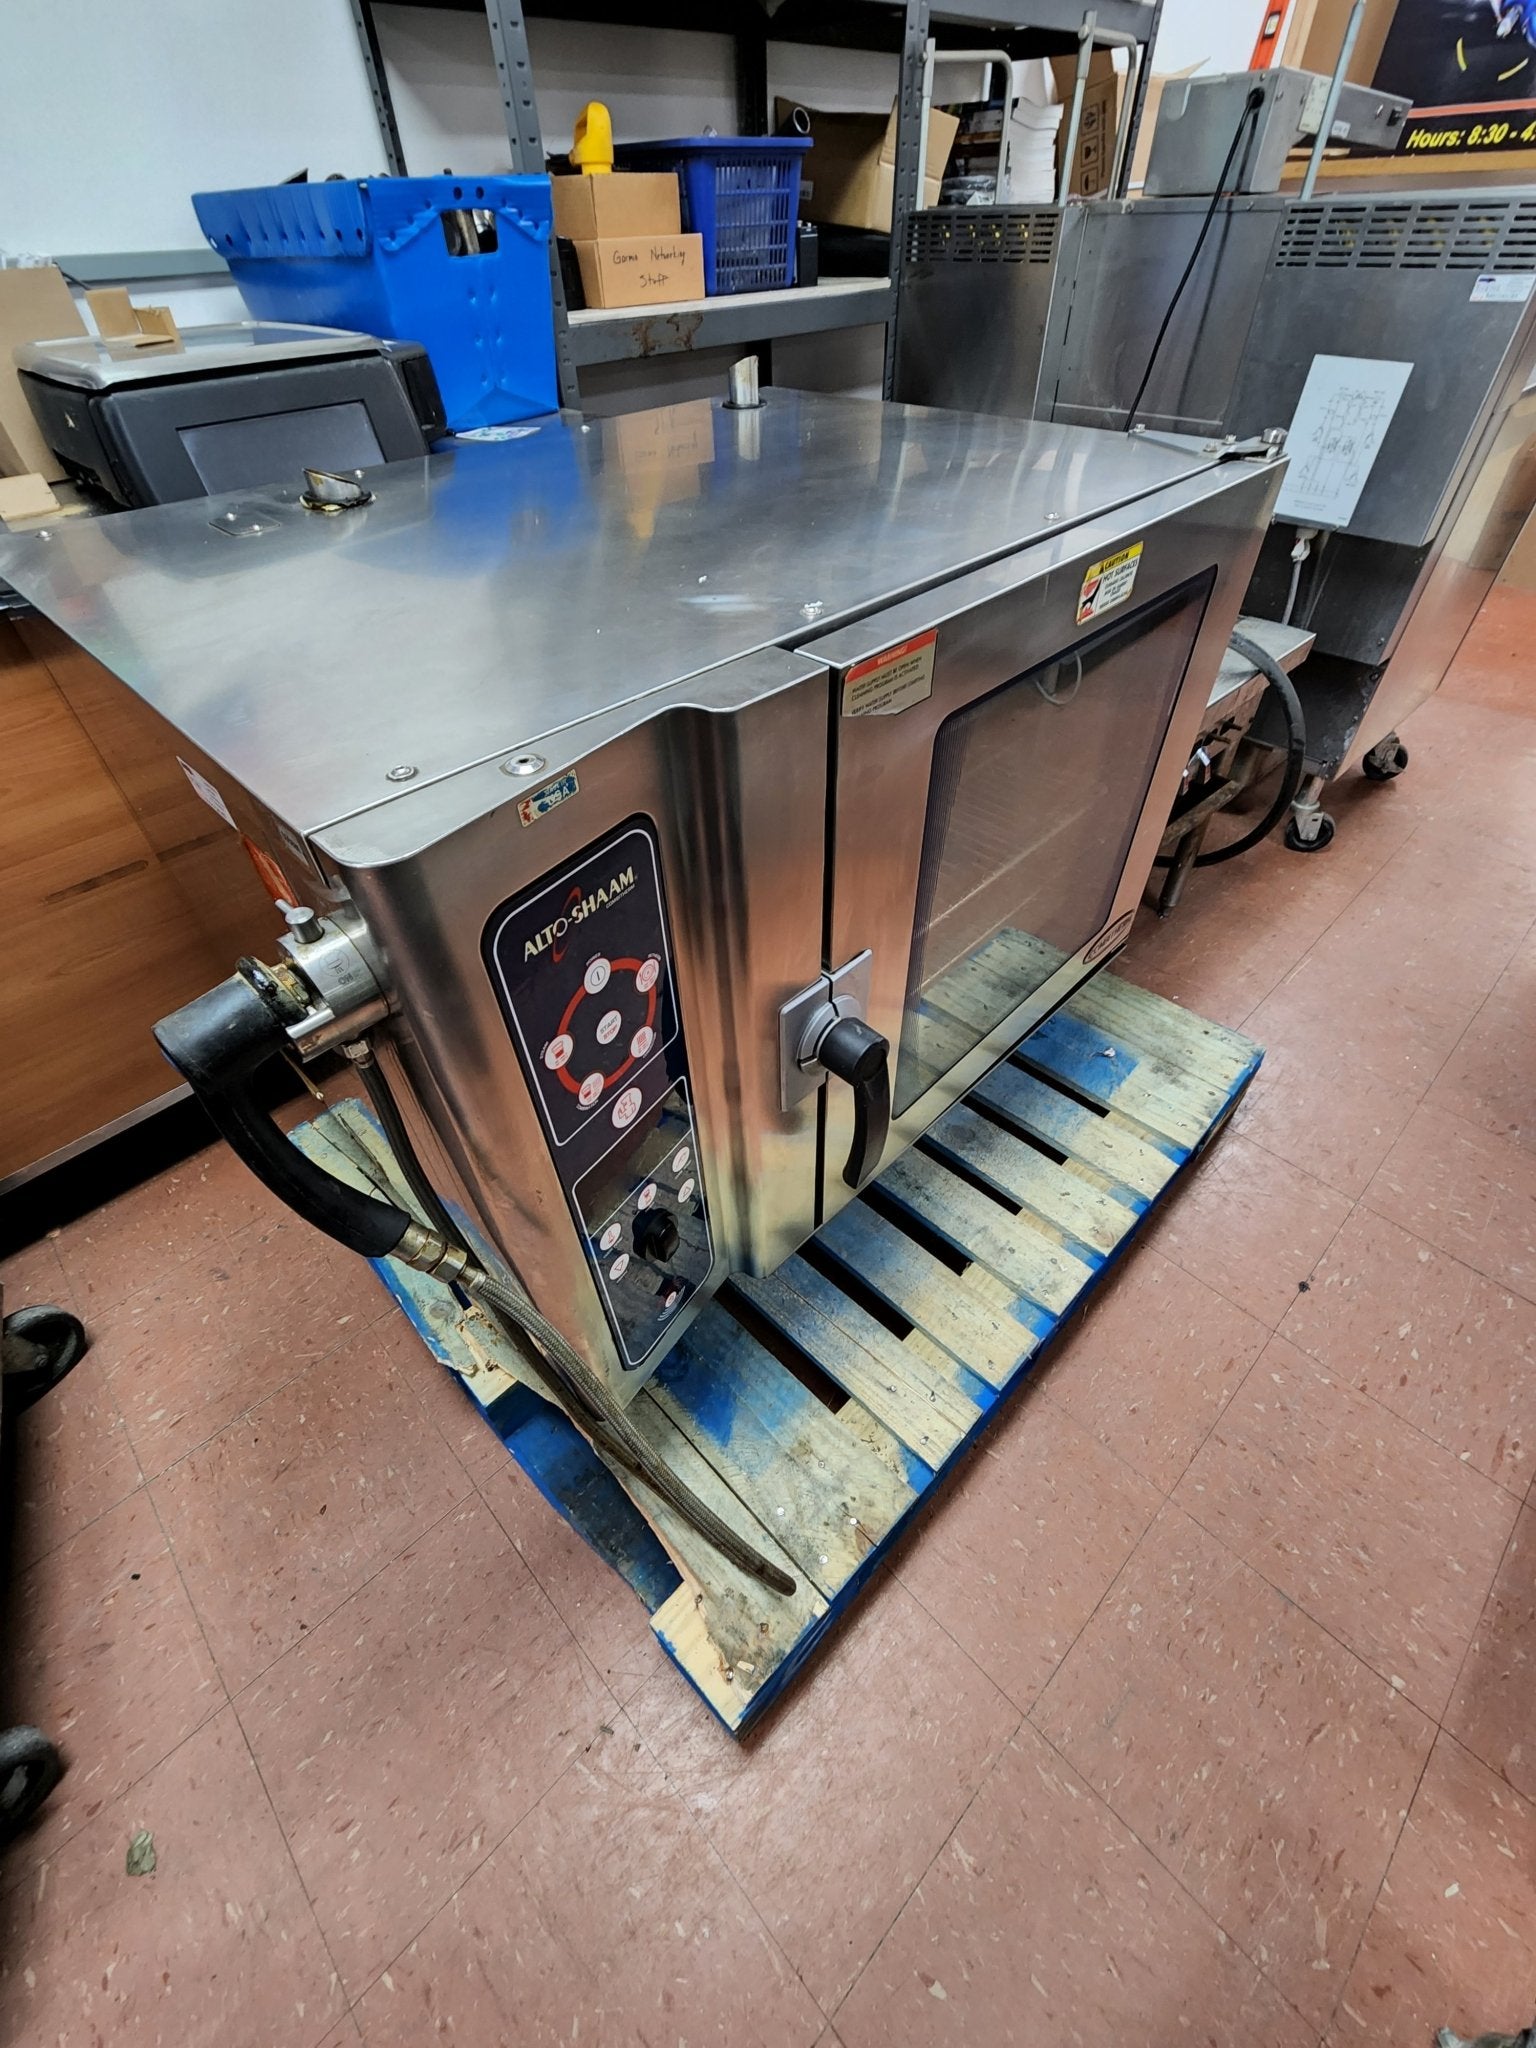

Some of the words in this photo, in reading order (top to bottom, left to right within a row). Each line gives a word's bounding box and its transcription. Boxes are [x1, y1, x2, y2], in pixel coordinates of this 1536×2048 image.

[1405, 128, 1466, 149] Hours:
[1467, 122, 1509, 146] 8:30
[1103, 570, 1114, 582] HOT
[1115, 559, 1139, 577] SURFACES
[1105, 551, 1130, 569] CAUTION
[524, 866, 635, 962] ALTO-SHAAM
[600, 1015, 618, 1034] START
[603, 1024, 618, 1040] STOP
